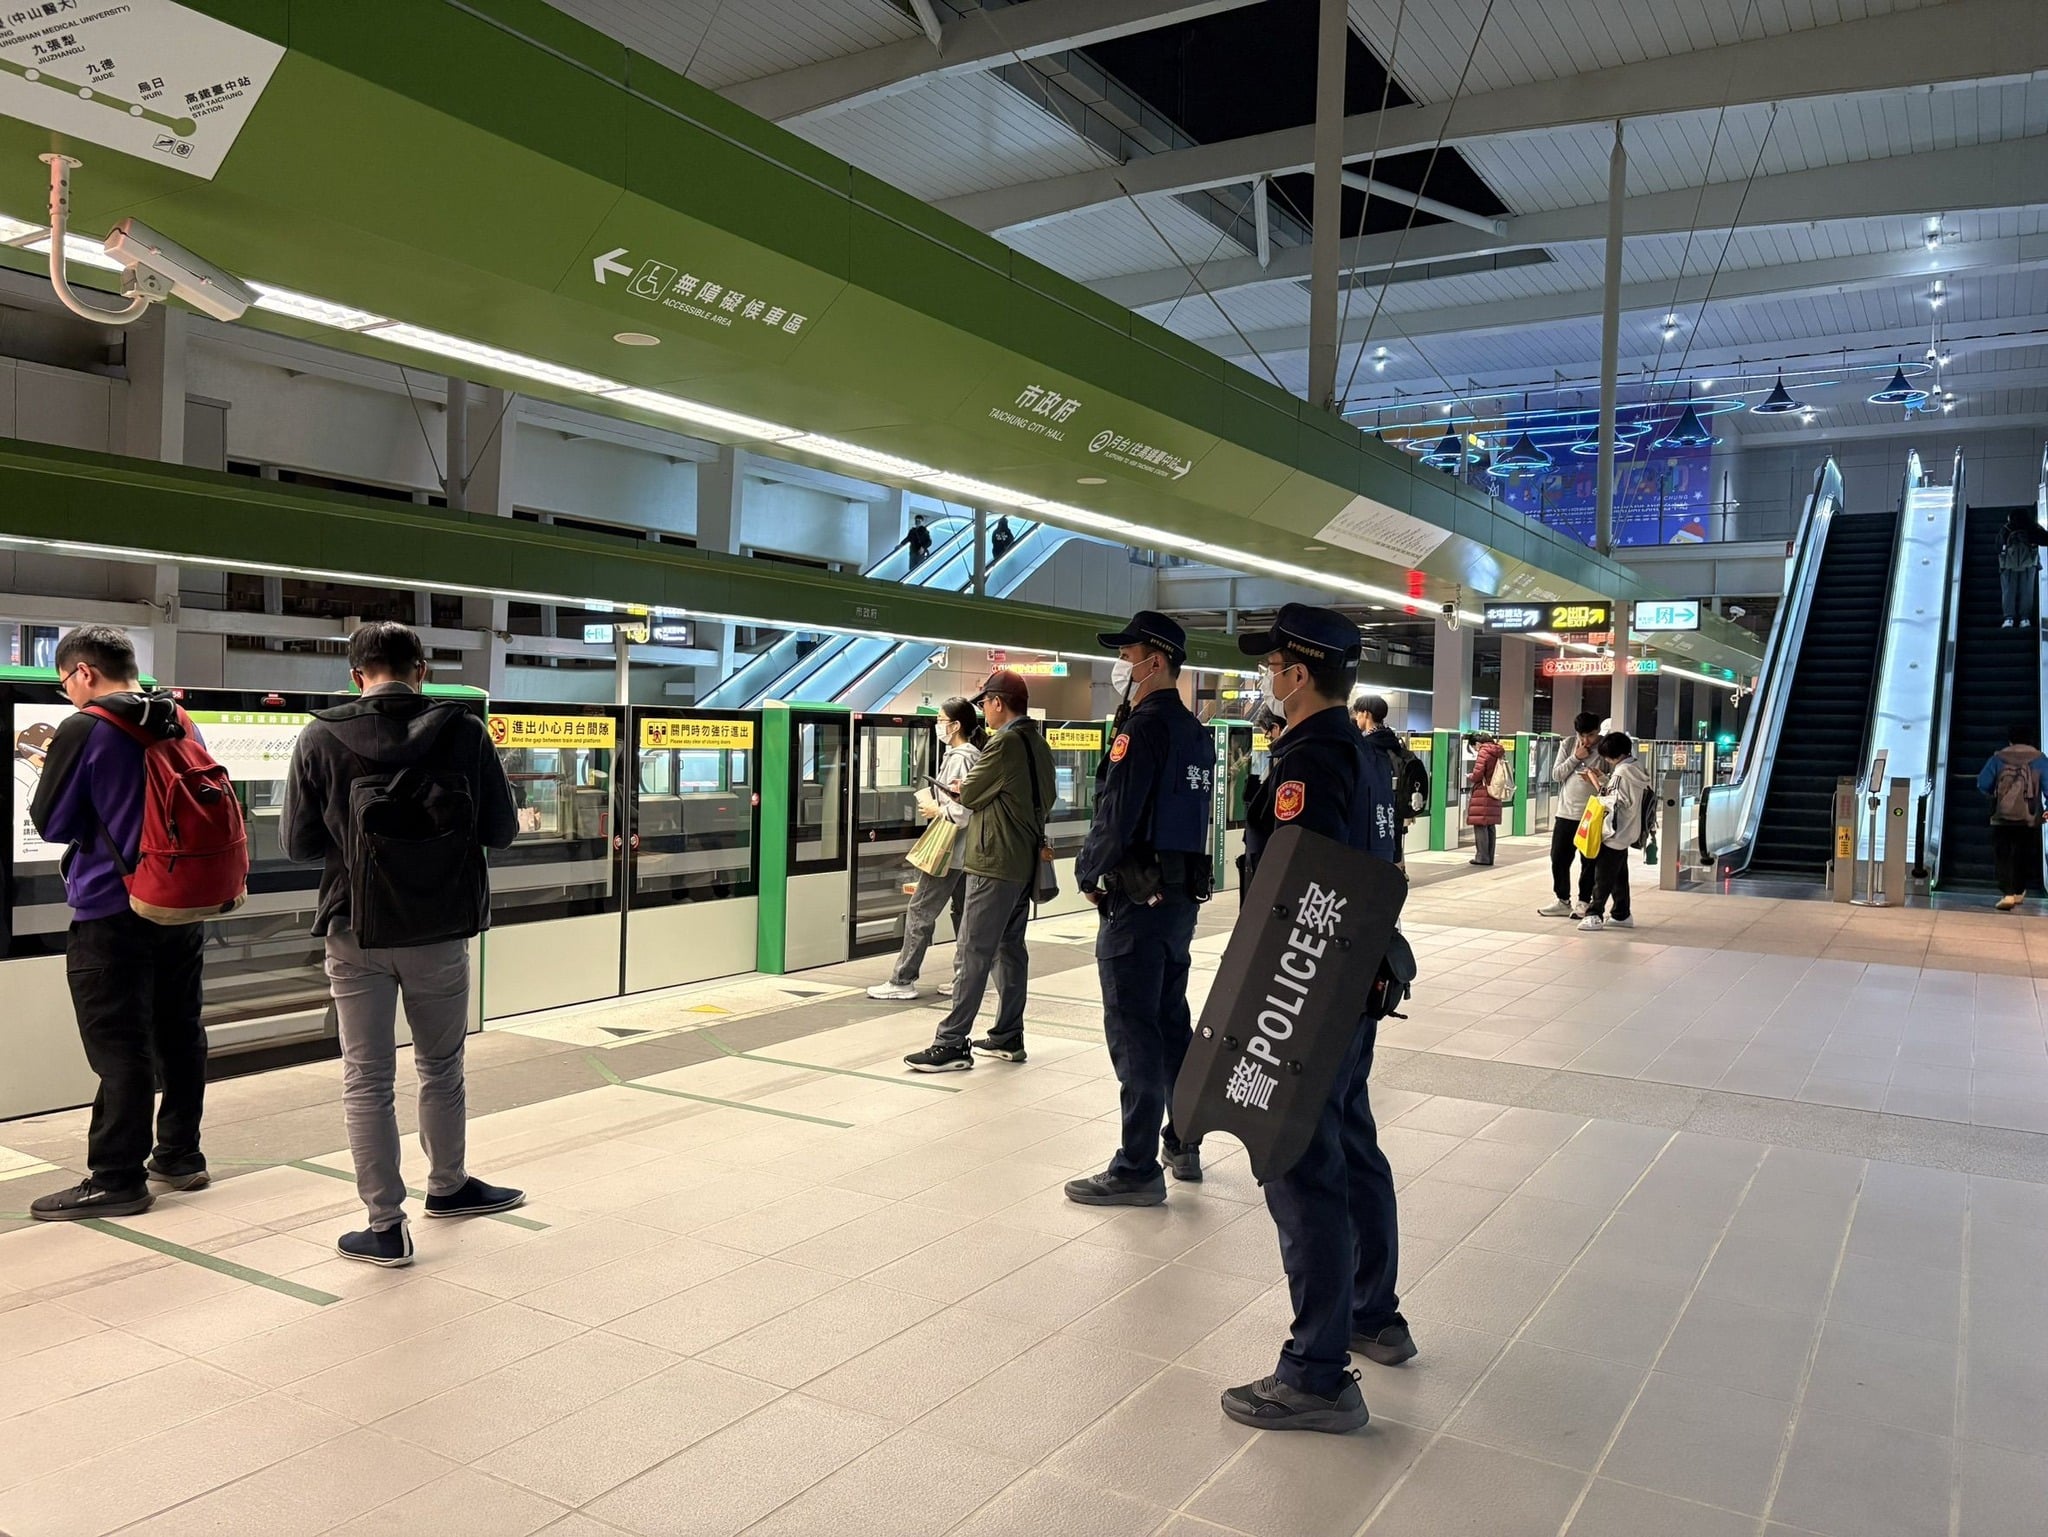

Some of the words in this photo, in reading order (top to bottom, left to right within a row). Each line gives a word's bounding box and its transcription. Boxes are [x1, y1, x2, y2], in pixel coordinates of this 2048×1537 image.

[42, 20, 79, 36] MEDICAL
[80, 5, 131, 24] UNIVERSITY)
[38, 45, 86, 65] JIUZHANGLI
[86, 58, 115, 75] 九德
[91, 72, 115, 83] JIUDE
[141, 90, 163, 101] WURI
[184, 75, 251, 104] 高鐵臺中站
[189, 102, 205, 112] HSR
[207, 90, 243, 106] TAICHUNG
[192, 104, 224, 119] STATION
[662, 297, 711, 320] ACCESSIBLE
[710, 313, 732, 328] AREA
[672, 273, 808, 335] 無障礙候車區
[1015, 384, 1082, 423] 市政府
[988, 407, 1029, 429] TAICHUNG
[1028, 422, 1048, 434] CITY
[1045, 427, 1065, 442] HALL
[1552, 606, 1567, 628] 2
[1567, 606, 1589, 618] 出口
[1568, 618, 1587, 627] EXIT
[512, 720, 609, 735] 進出小心月台間隙
